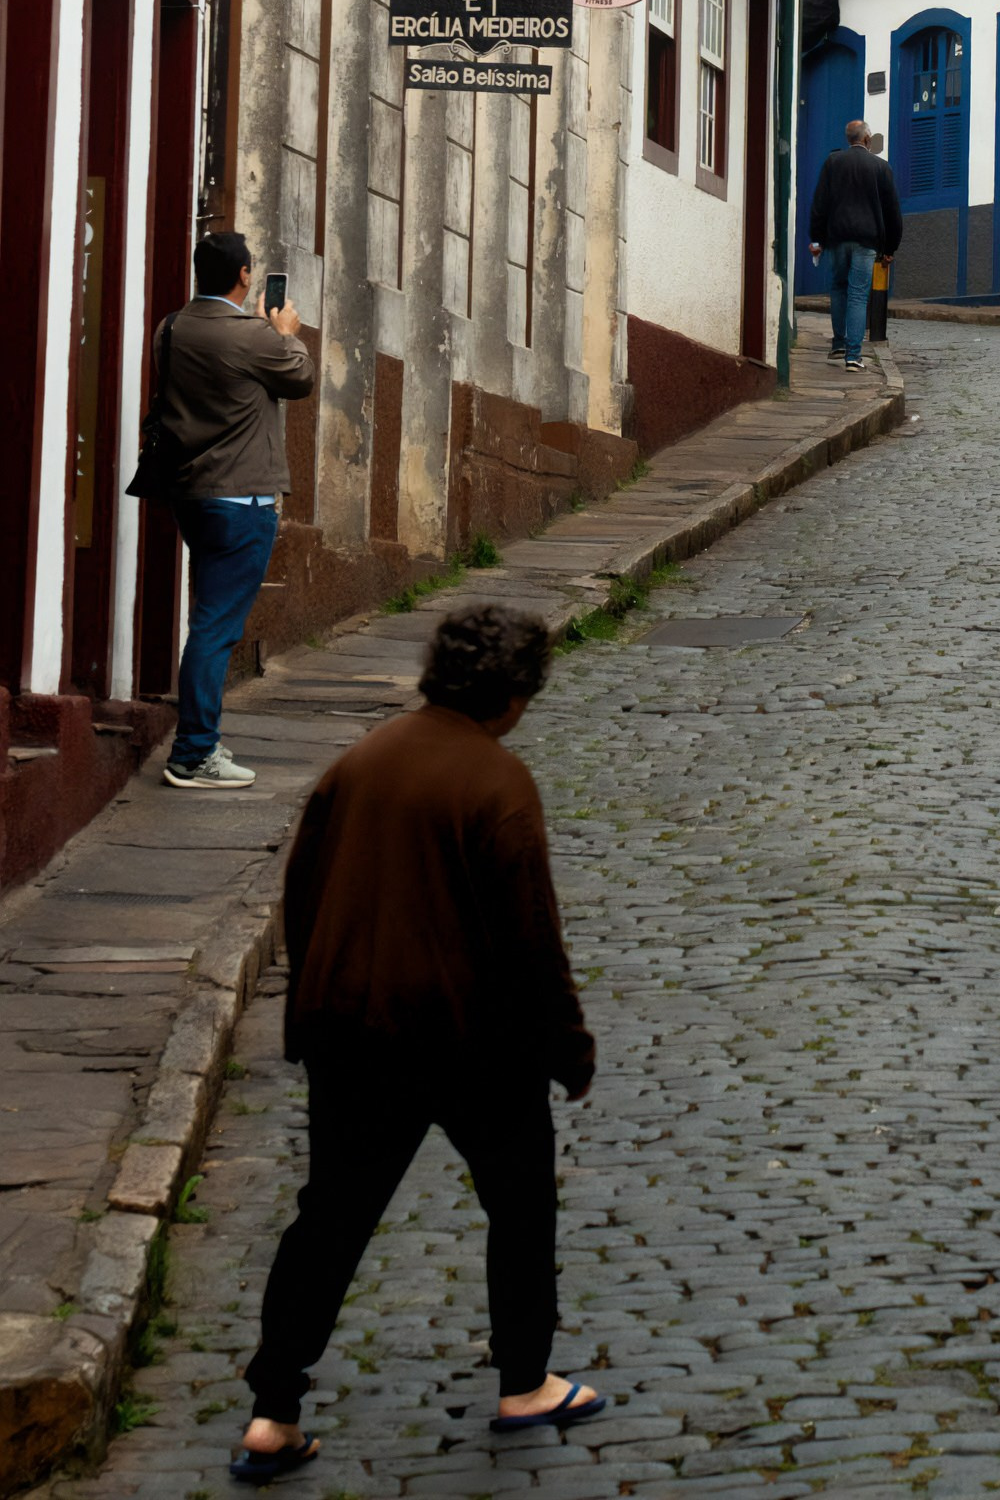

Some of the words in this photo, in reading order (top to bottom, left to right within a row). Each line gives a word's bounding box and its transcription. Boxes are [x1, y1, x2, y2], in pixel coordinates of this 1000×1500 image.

[391, 11, 464, 39] ERCÍLIA
[469, 16, 570, 40] MEDEIROS
[408, 63, 460, 85] Salão
[462, 67, 550, 90] Belíssima
